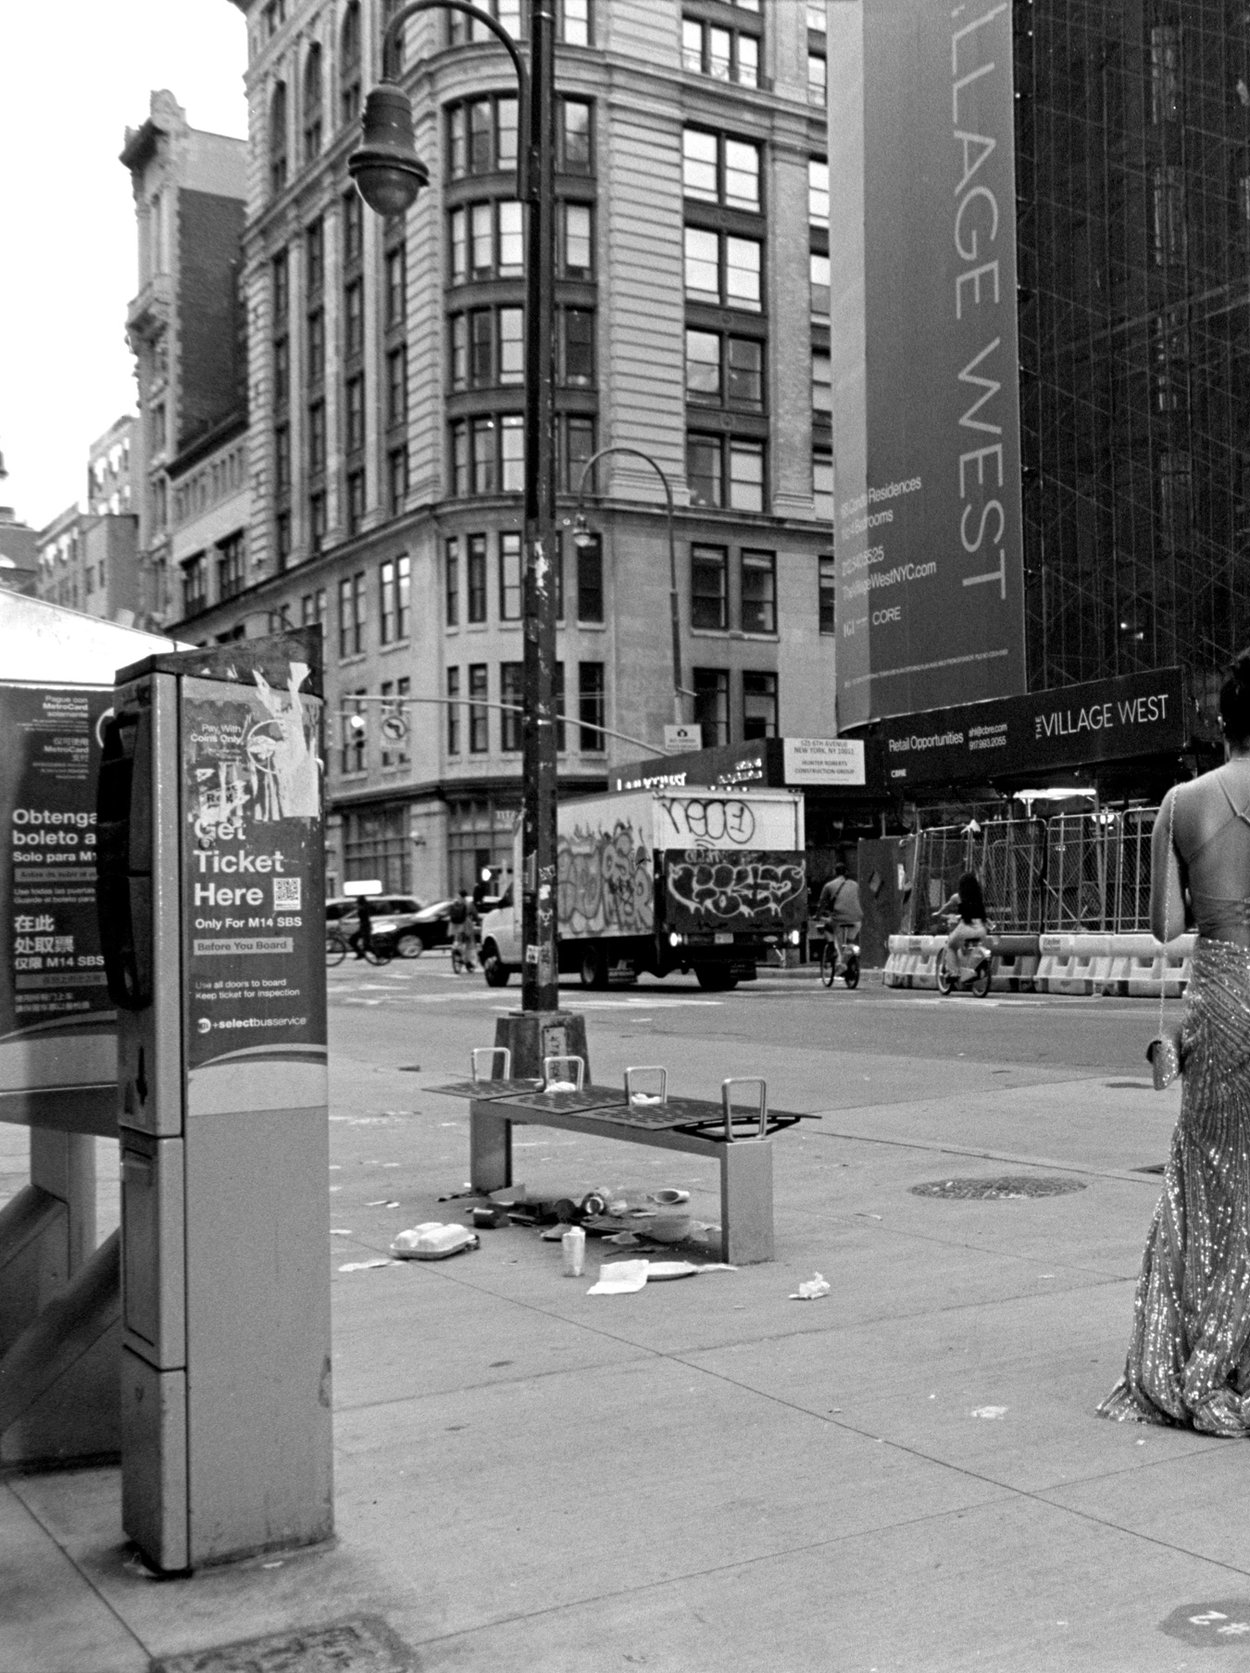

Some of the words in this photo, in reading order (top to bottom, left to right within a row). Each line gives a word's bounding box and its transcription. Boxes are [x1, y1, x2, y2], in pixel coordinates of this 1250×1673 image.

[951, 0, 1007, 320] LLAGE
[957, 336, 1006, 600] WEST
[868, 476, 922, 504] Residences
[871, 605, 902, 626] CORE
[1041, 703, 1113, 737] VILLAGE
[1117, 694, 1169, 725] WEST
[190, 733, 218, 742] Coins
[201, 724, 219, 735] Pay
[221, 724, 241, 733] With
[794, 746, 808, 754] NEW
[888, 736, 910, 753] Retail
[910, 730, 965, 751] Opportunities
[12, 809, 98, 828] Obtenga
[13, 829, 79, 845] boleto
[194, 818, 246, 840] Get
[13, 851, 43, 862] Solo
[46, 853, 76, 863] para
[193, 850, 285, 873] Ticket
[194, 882, 264, 906] Here
[14, 914, 55, 933] 在此
[195, 918, 222, 931] Only
[225, 918, 245, 928] For
[248, 917, 274, 928] M14
[276, 916, 303, 928] SBS
[14, 935, 75, 955] 处取票
[197, 941, 231, 952] Before
[234, 941, 253, 951] You
[256, 940, 287, 950] Board
[46, 956, 74, 967] M14
[77, 955, 105, 967] SBS
[225, 980, 249, 988] doors
[251, 979, 260, 988] to
[262, 978, 287, 987] board
[219, 990, 242, 999] ticket
[244, 989, 255, 998] for
[257, 988, 300, 999] inspection
